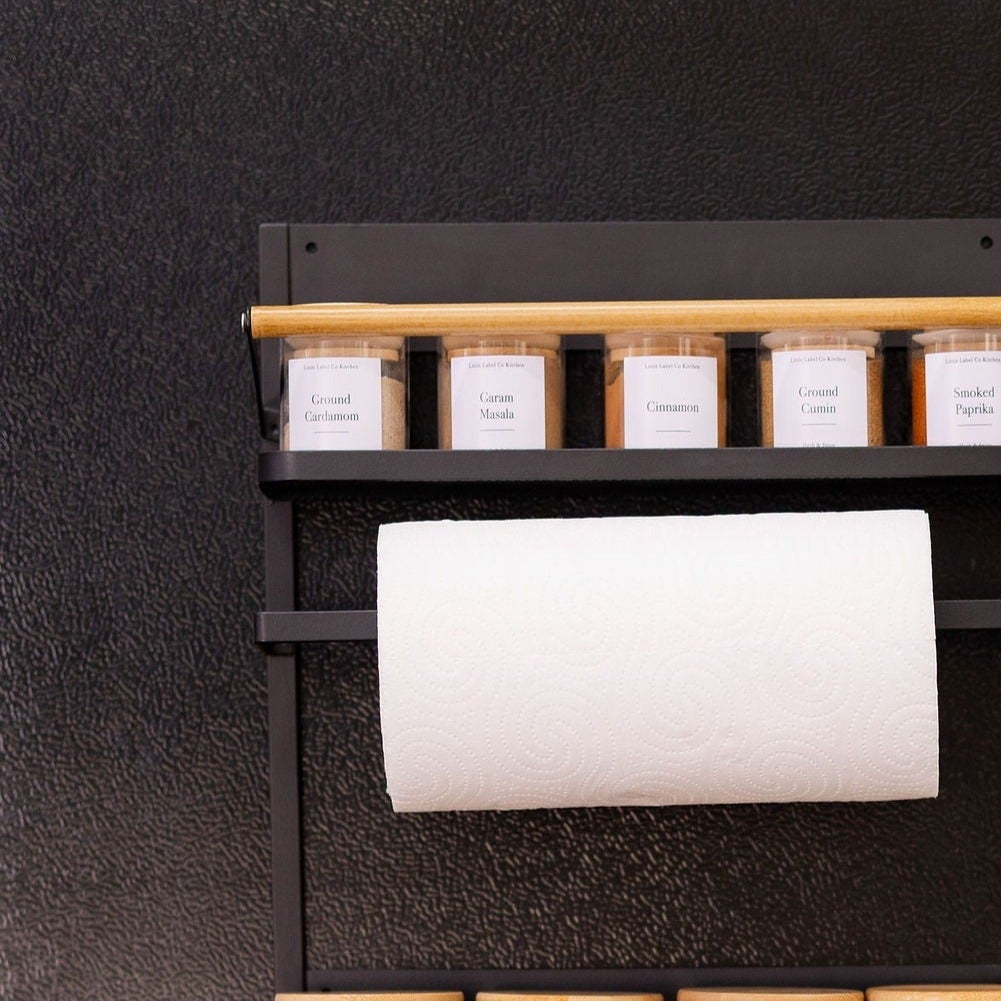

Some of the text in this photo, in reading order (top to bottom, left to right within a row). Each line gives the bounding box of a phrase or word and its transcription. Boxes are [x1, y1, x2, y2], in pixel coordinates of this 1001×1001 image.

[479, 392, 514, 403] Garam
[798, 386, 839, 397] Ground
[953, 386, 995, 398] Smoked
[311, 394, 351, 405] Ground
[646, 400, 699, 413] Cinnamon
[801, 403, 836, 414] Cumin
[955, 403, 994, 418] Paprika
[304, 410, 360, 422] Cardamom
[480, 408, 515, 420] Masala
